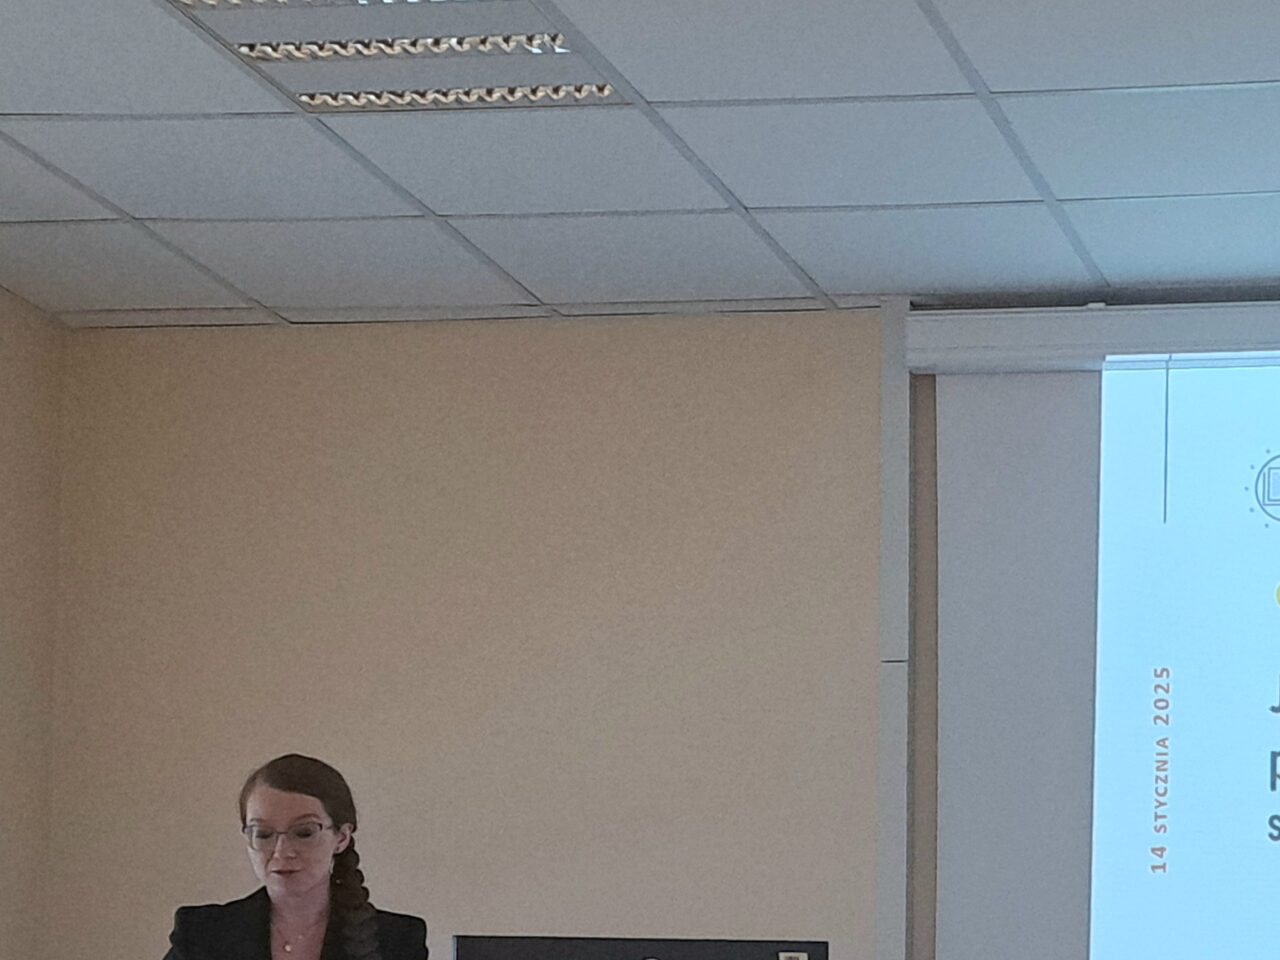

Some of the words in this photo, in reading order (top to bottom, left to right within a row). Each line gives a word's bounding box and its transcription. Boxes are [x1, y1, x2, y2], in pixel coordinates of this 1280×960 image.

[1153, 667, 1170, 726] 2025
[1153, 737, 1169, 834] STYCZNIA
[1151, 847, 1167, 873] 14
